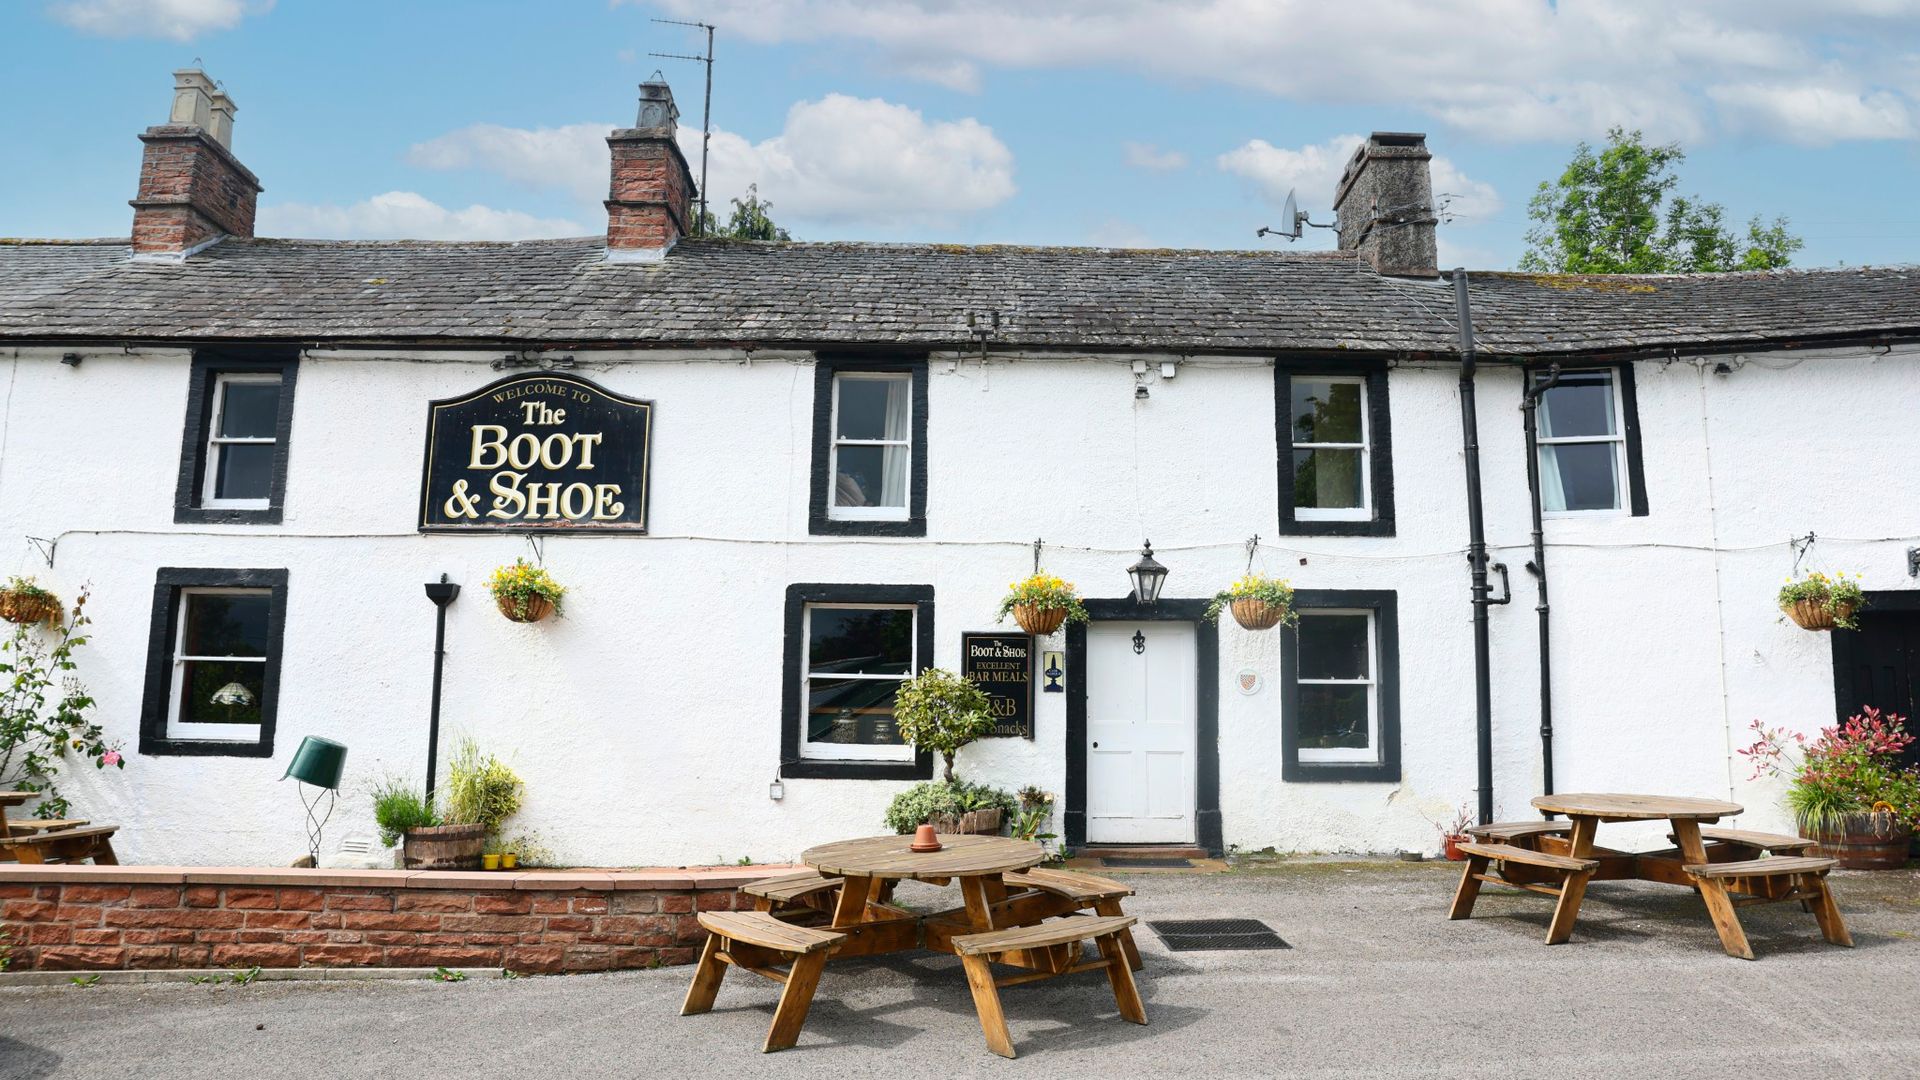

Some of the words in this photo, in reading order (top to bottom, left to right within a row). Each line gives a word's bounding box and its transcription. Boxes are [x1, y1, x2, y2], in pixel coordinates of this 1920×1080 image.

[492, 383, 568, 404] WELCOME
[572, 389, 591, 404] TO
[520, 400, 566, 425] The
[467, 424, 602, 470] BOOT
[444, 479, 481, 519] &
[486, 471, 625, 520] SHOE
[970, 645, 994, 657] BOOT
[995, 648, 1002, 658] &
[1002, 645, 1027, 658] SHOE
[969, 671, 990, 682] BAR
[992, 671, 1028, 682] MEALS
[976, 662, 1020, 670] EXCELLENT
